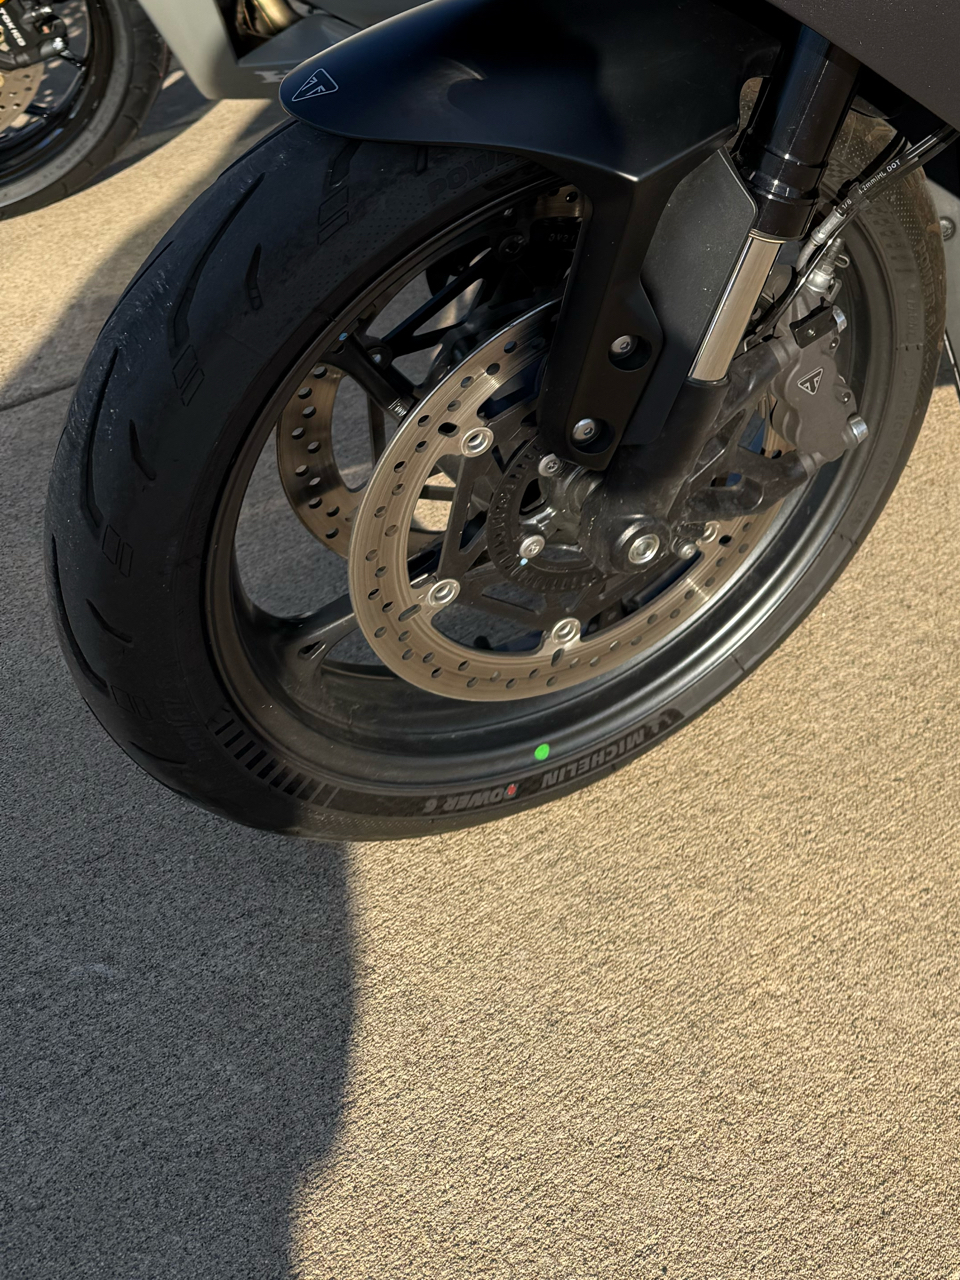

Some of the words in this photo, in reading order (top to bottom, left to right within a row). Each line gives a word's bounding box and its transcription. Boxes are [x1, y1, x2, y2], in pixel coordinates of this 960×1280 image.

[886, 158, 901, 173] DOT
[541, 728, 646, 790] MICHELIN
[422, 799, 438, 814] 6
